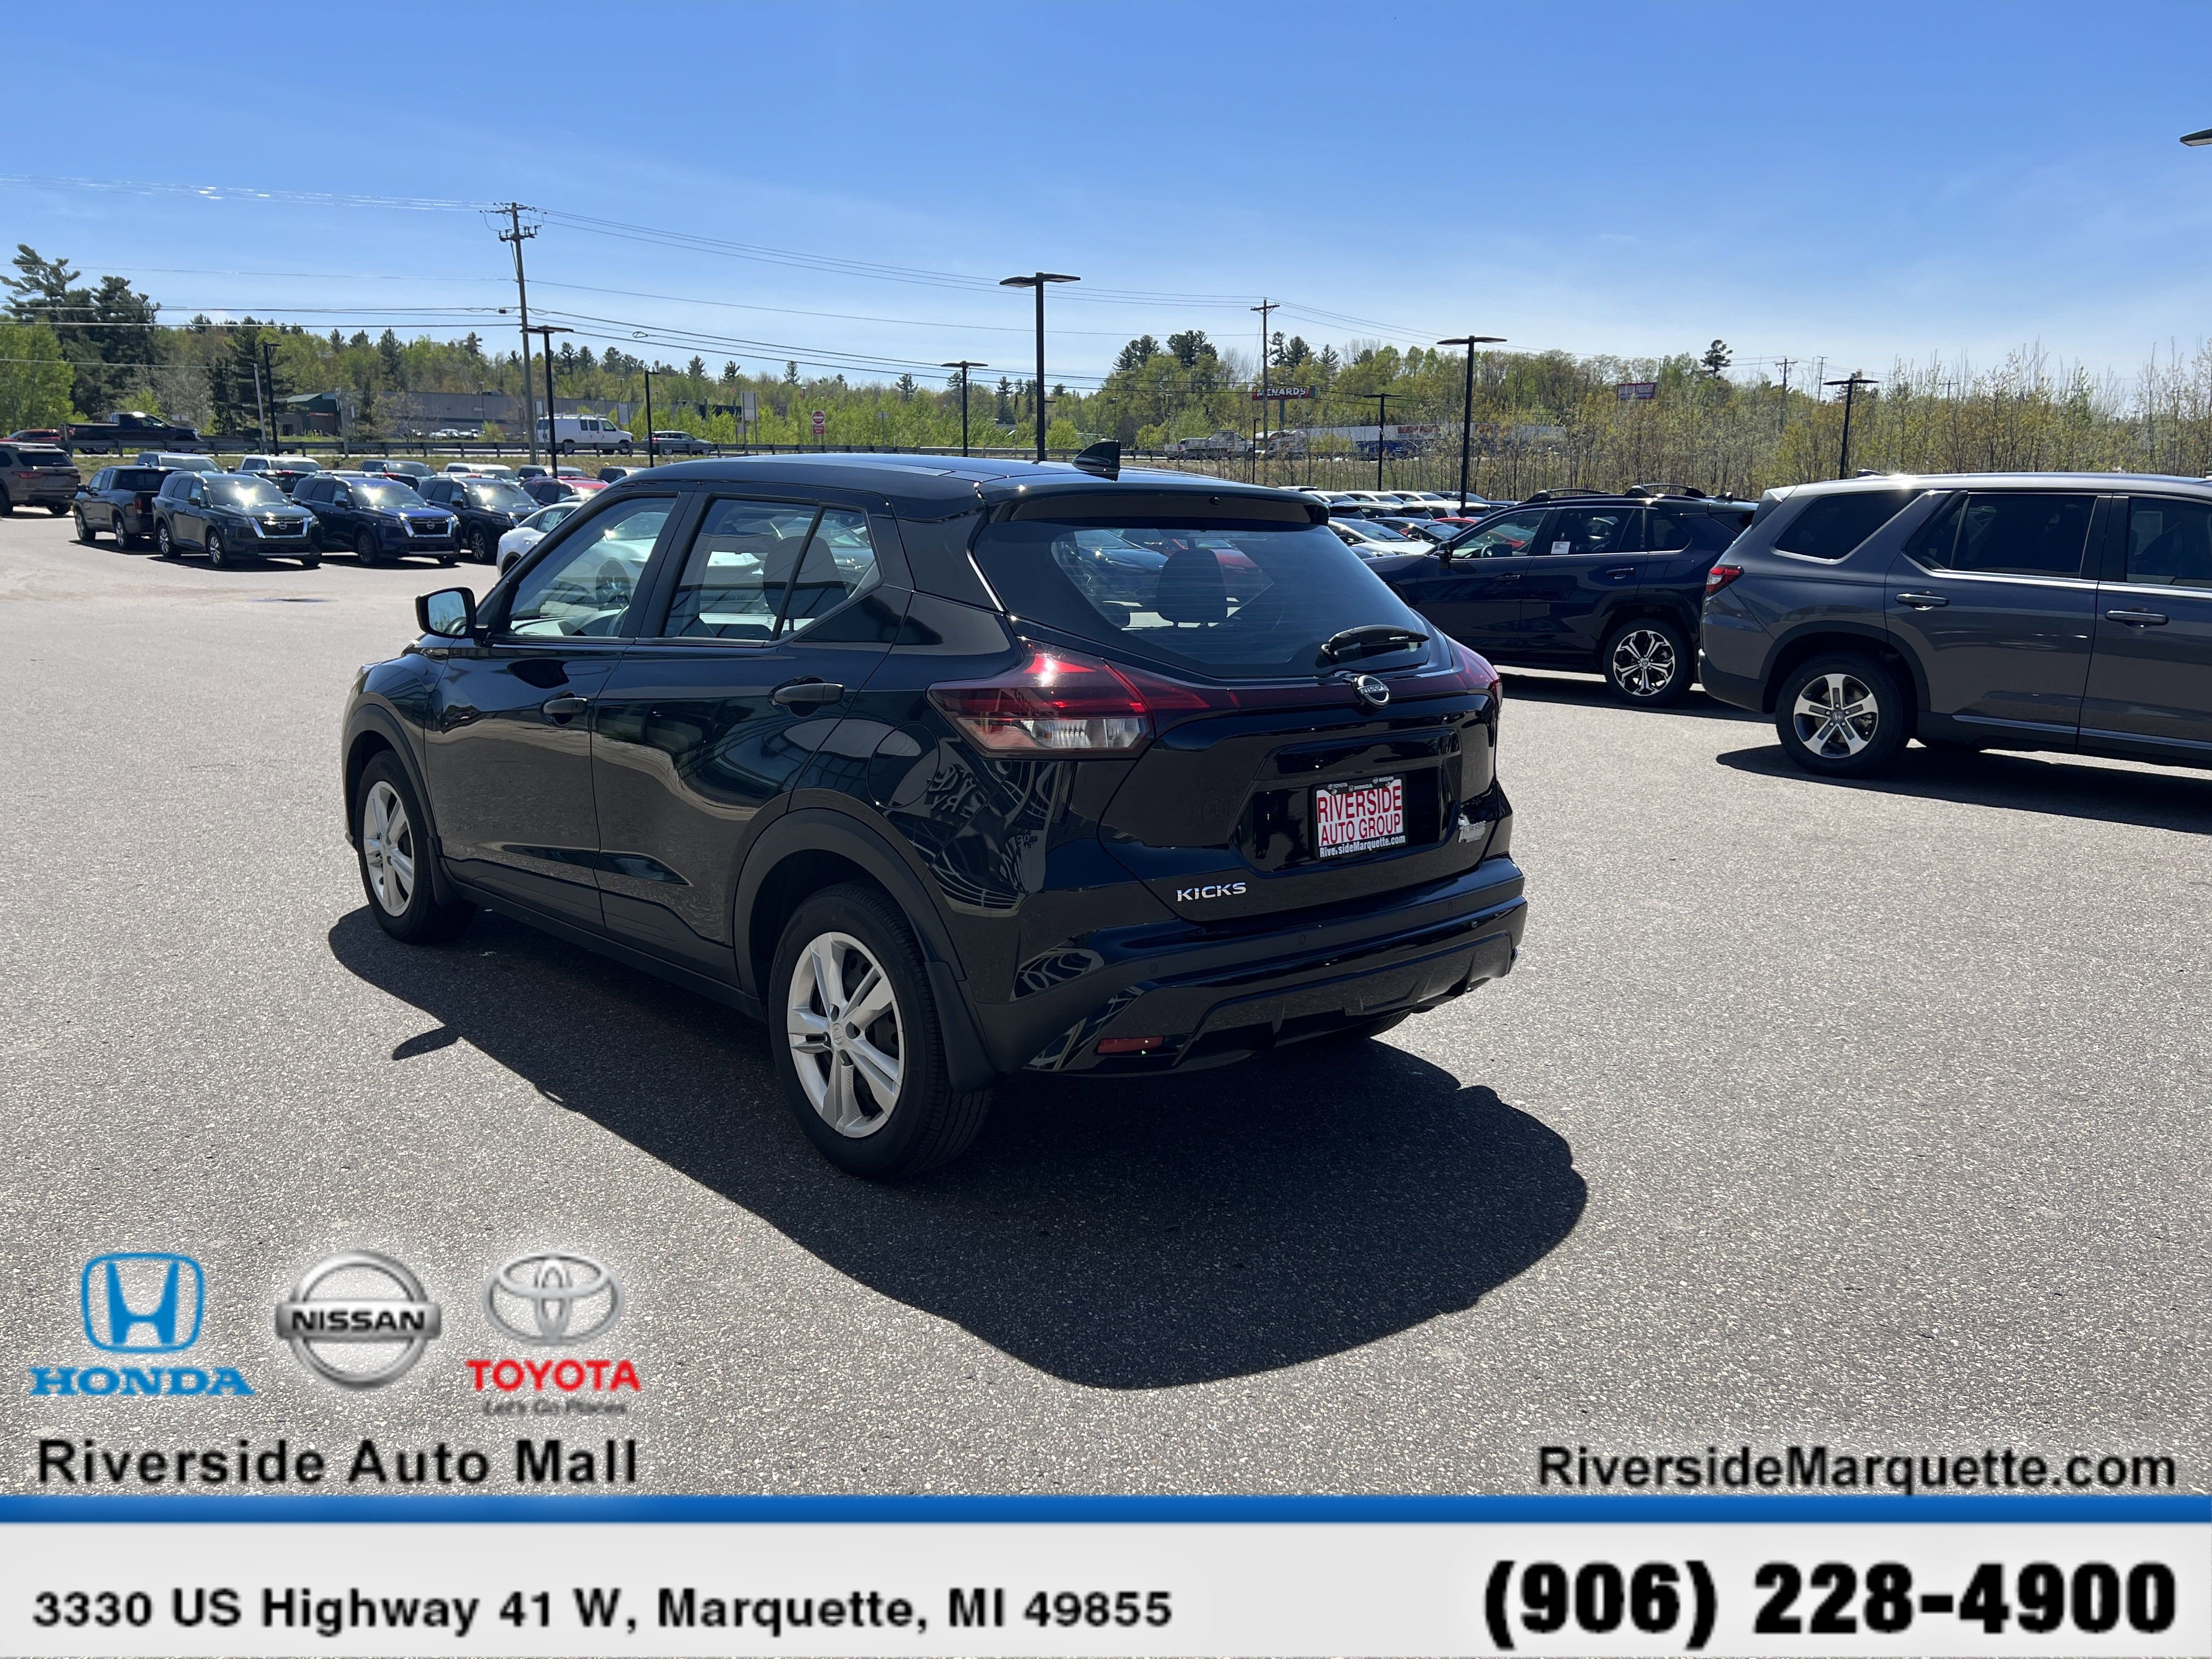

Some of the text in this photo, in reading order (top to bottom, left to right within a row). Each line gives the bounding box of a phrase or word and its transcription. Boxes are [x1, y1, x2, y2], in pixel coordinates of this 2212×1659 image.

[1256, 387, 1306, 397] MENARDS
[1317, 786, 1402, 823] RIVERSIDE
[1321, 813, 1401, 845] AUTO GROUP
[1176, 882, 1247, 902] KICKS
